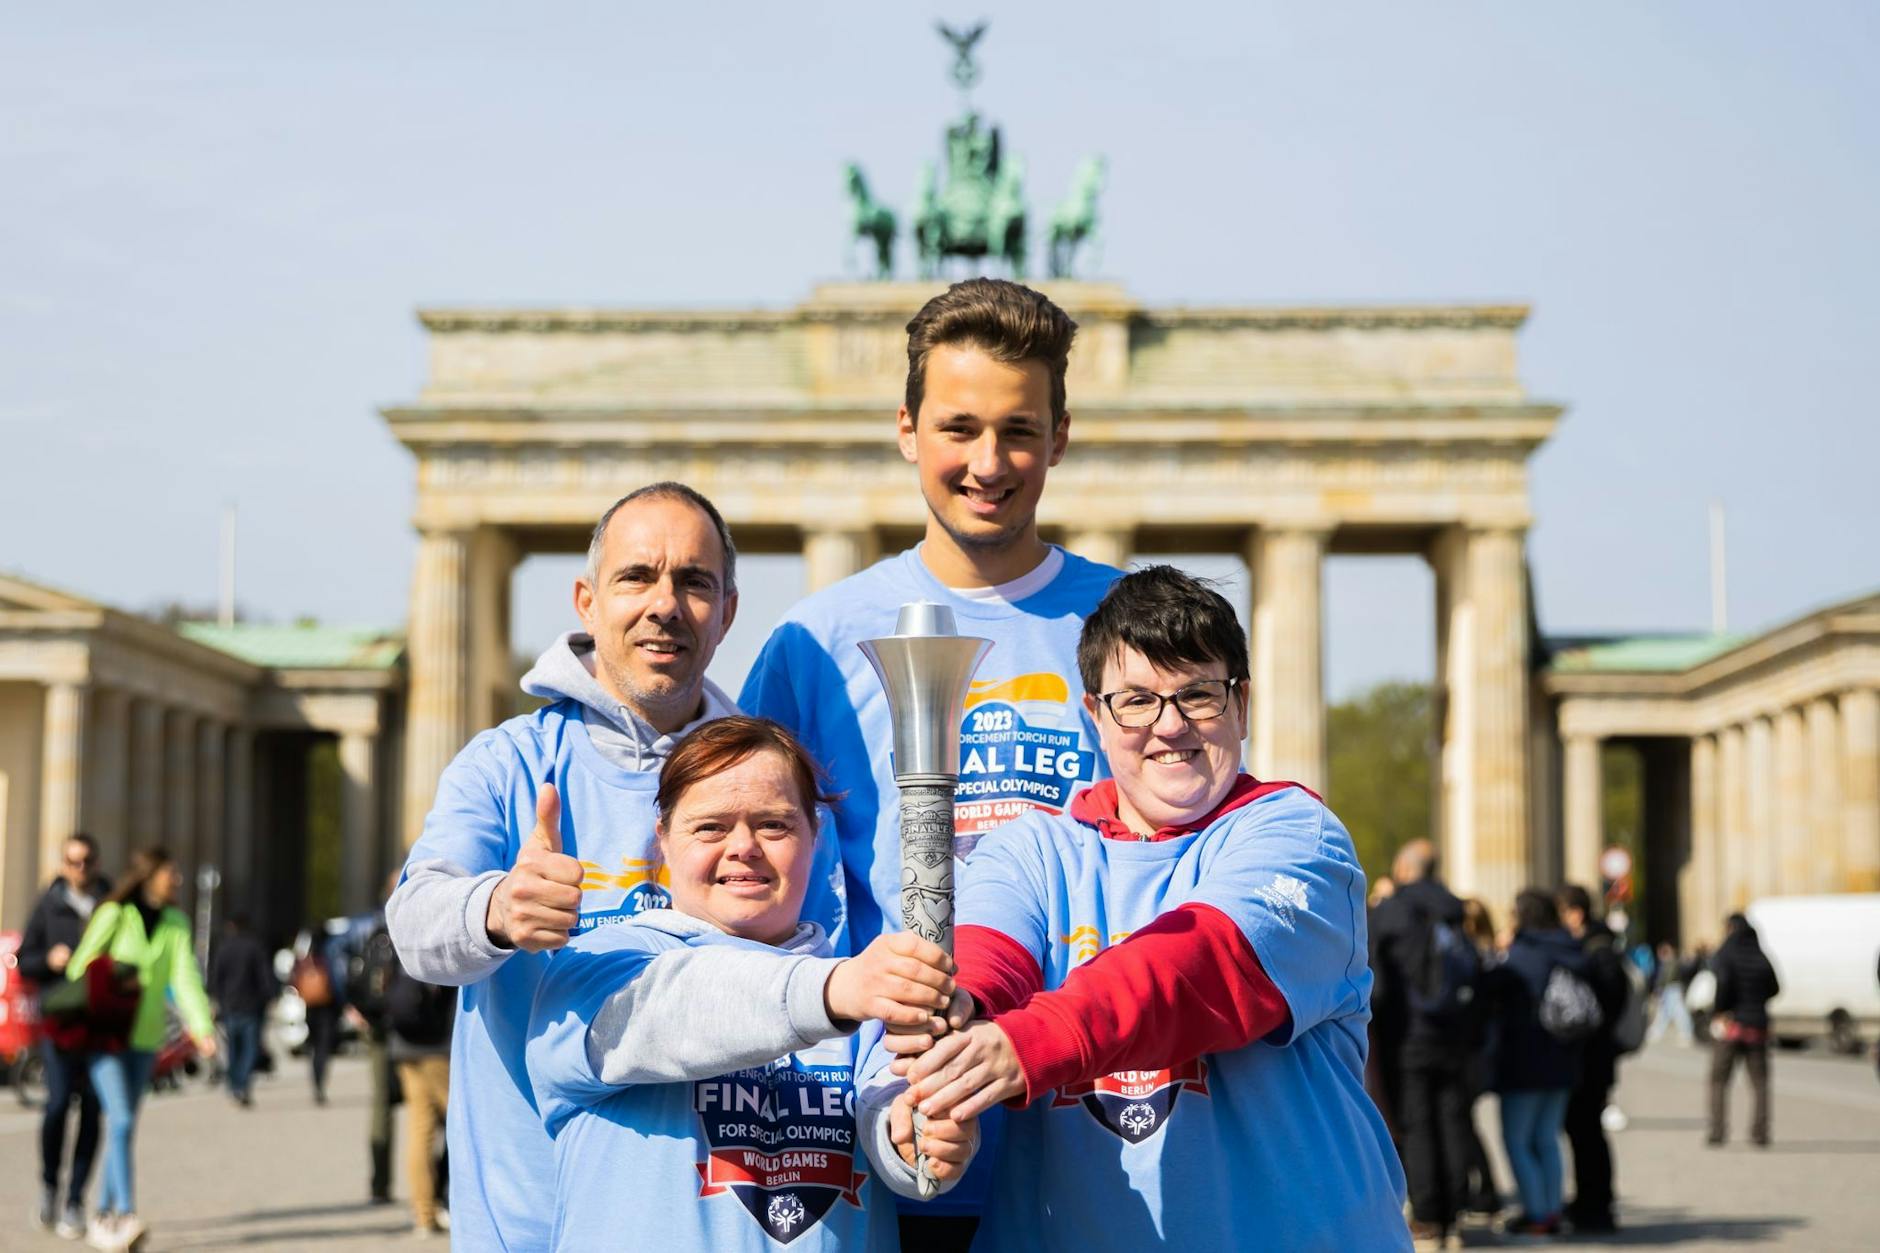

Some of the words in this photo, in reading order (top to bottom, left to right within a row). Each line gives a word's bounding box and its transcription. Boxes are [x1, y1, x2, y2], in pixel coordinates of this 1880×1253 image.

[973, 710, 1012, 732] 2023
[959, 732, 1011, 744] ORCEMENT
[1013, 731, 1047, 743] TORCH
[1048, 735, 1071, 746] RUN
[961, 747, 1006, 775] AL
[1014, 745, 1080, 779] LEG
[1000, 779, 1060, 800] OLYMPICS
[577, 918, 596, 929] AW
[793, 1071, 829, 1083] TORCH
[831, 1071, 852, 1083] RUN
[1108, 1070, 1138, 1083] RLD
[1121, 1082, 1155, 1095] BERLIN
[698, 1083, 790, 1122] FINAL
[719, 1124, 747, 1139] FOR
[749, 1124, 785, 1145] SPECIAL
[786, 1125, 852, 1144] OLYMPICS
[743, 1151, 781, 1172] WORLD
[782, 1153, 828, 1169] GAMES
[766, 1171, 801, 1186] BERLIN
